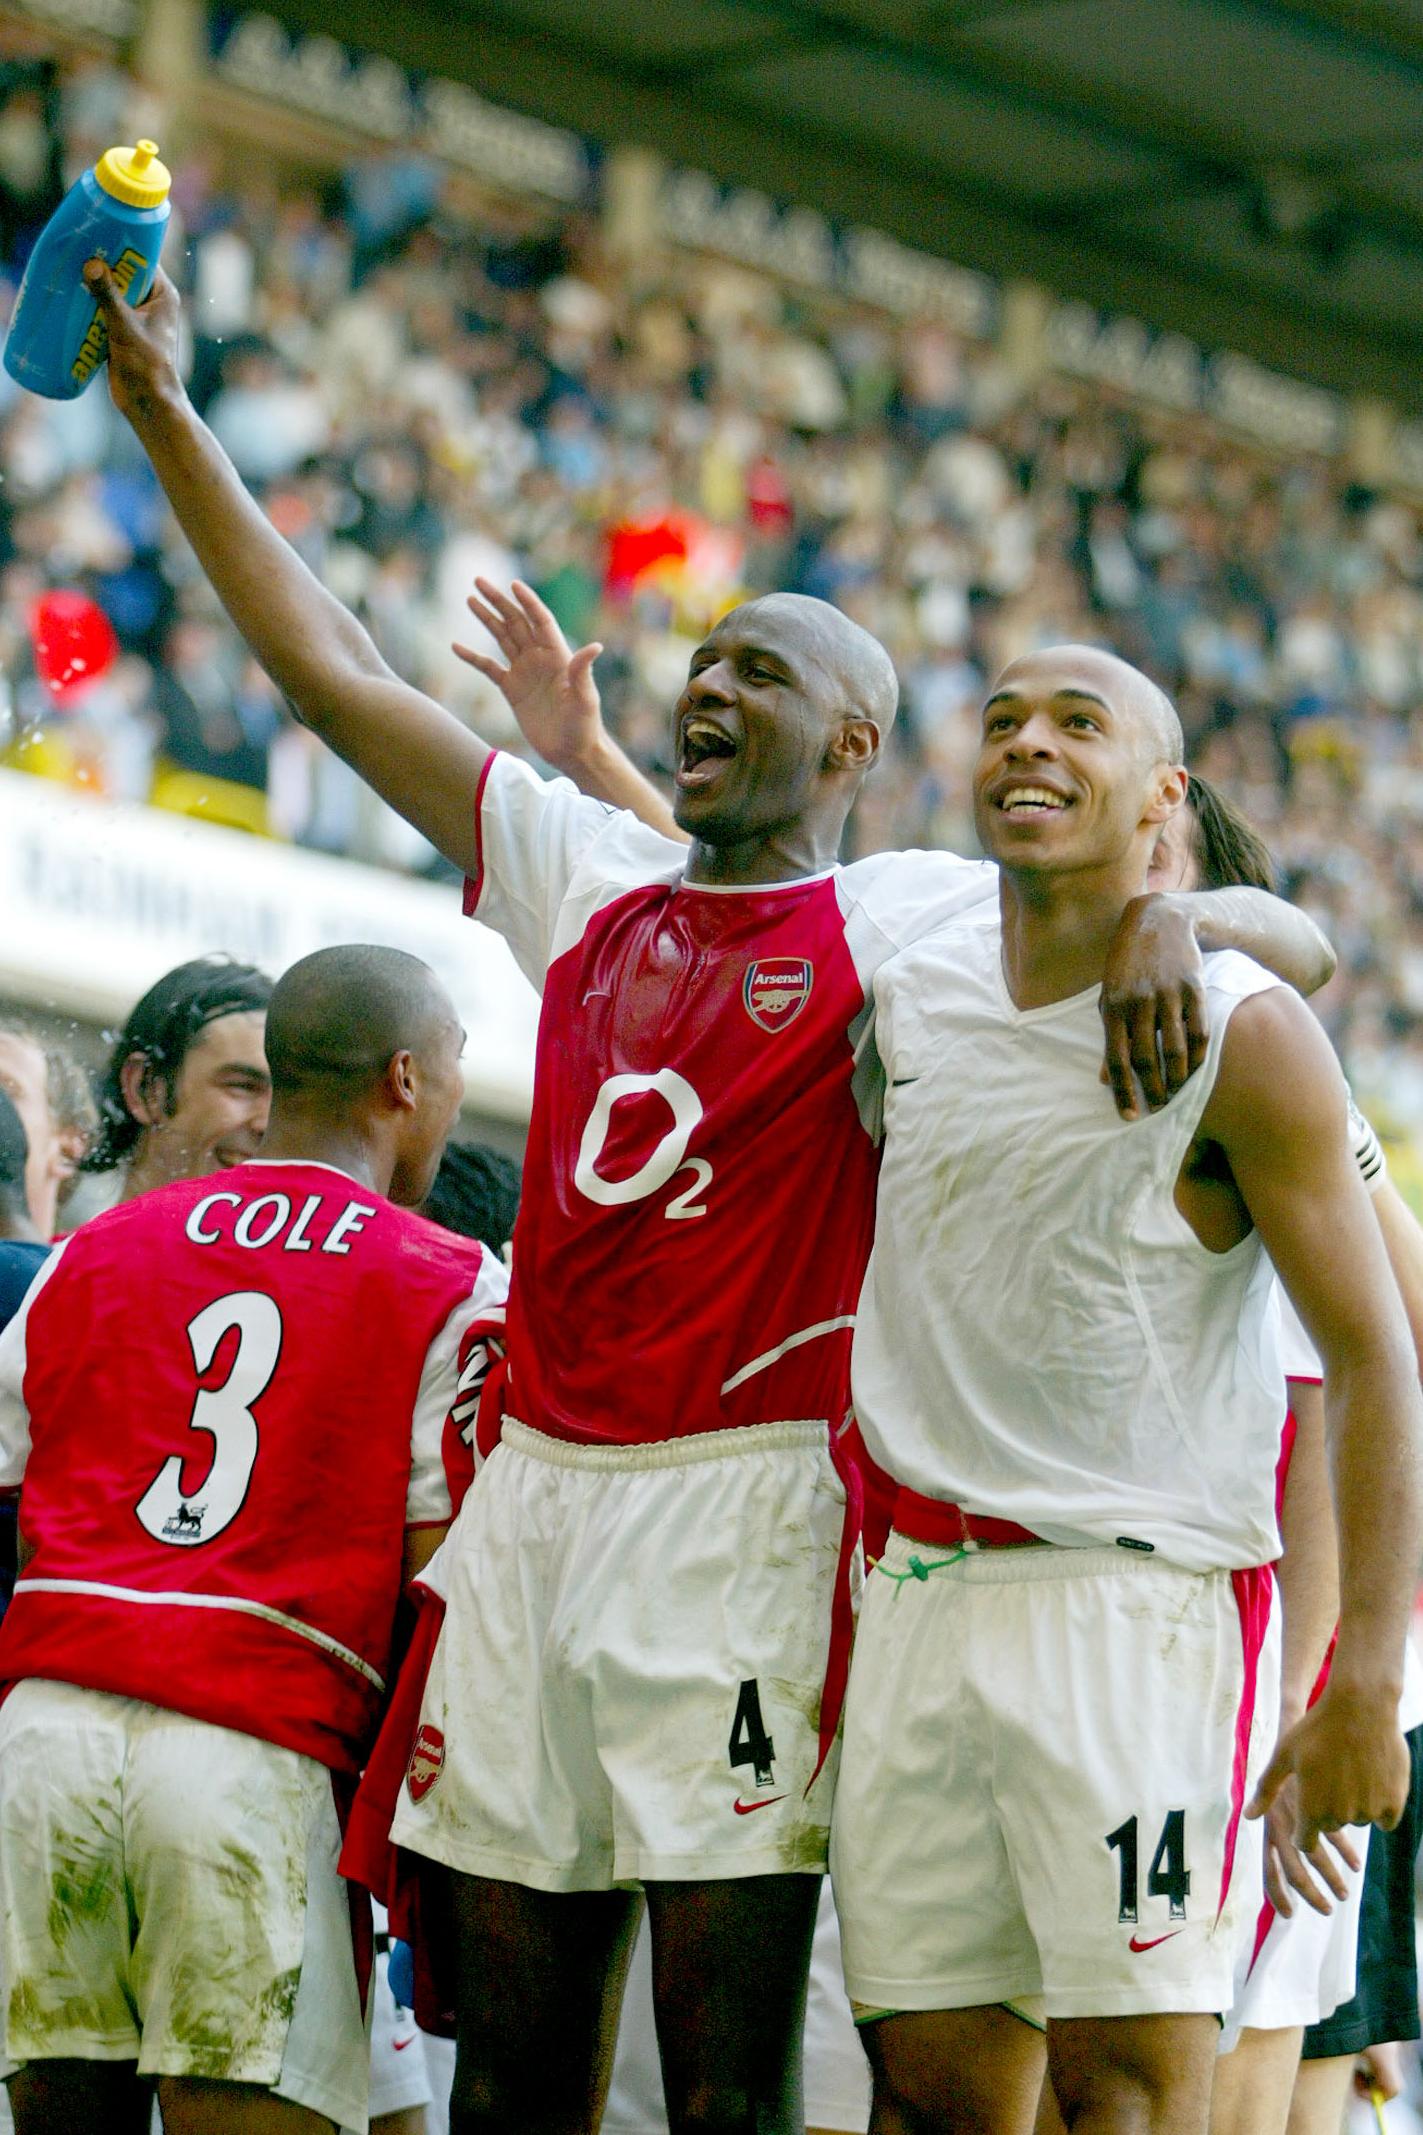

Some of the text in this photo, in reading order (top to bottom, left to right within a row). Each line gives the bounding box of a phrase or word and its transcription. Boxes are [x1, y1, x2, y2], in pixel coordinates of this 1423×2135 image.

[72, 247, 148, 384] Lucade
[754, 972, 804, 985] Arsenal
[574, 1067, 714, 1220] O2
[185, 1191, 377, 1256] COLE
[135, 1290, 283, 1546] 3
[728, 1678, 776, 1788] 4
[1104, 1809, 1191, 1924] 14
